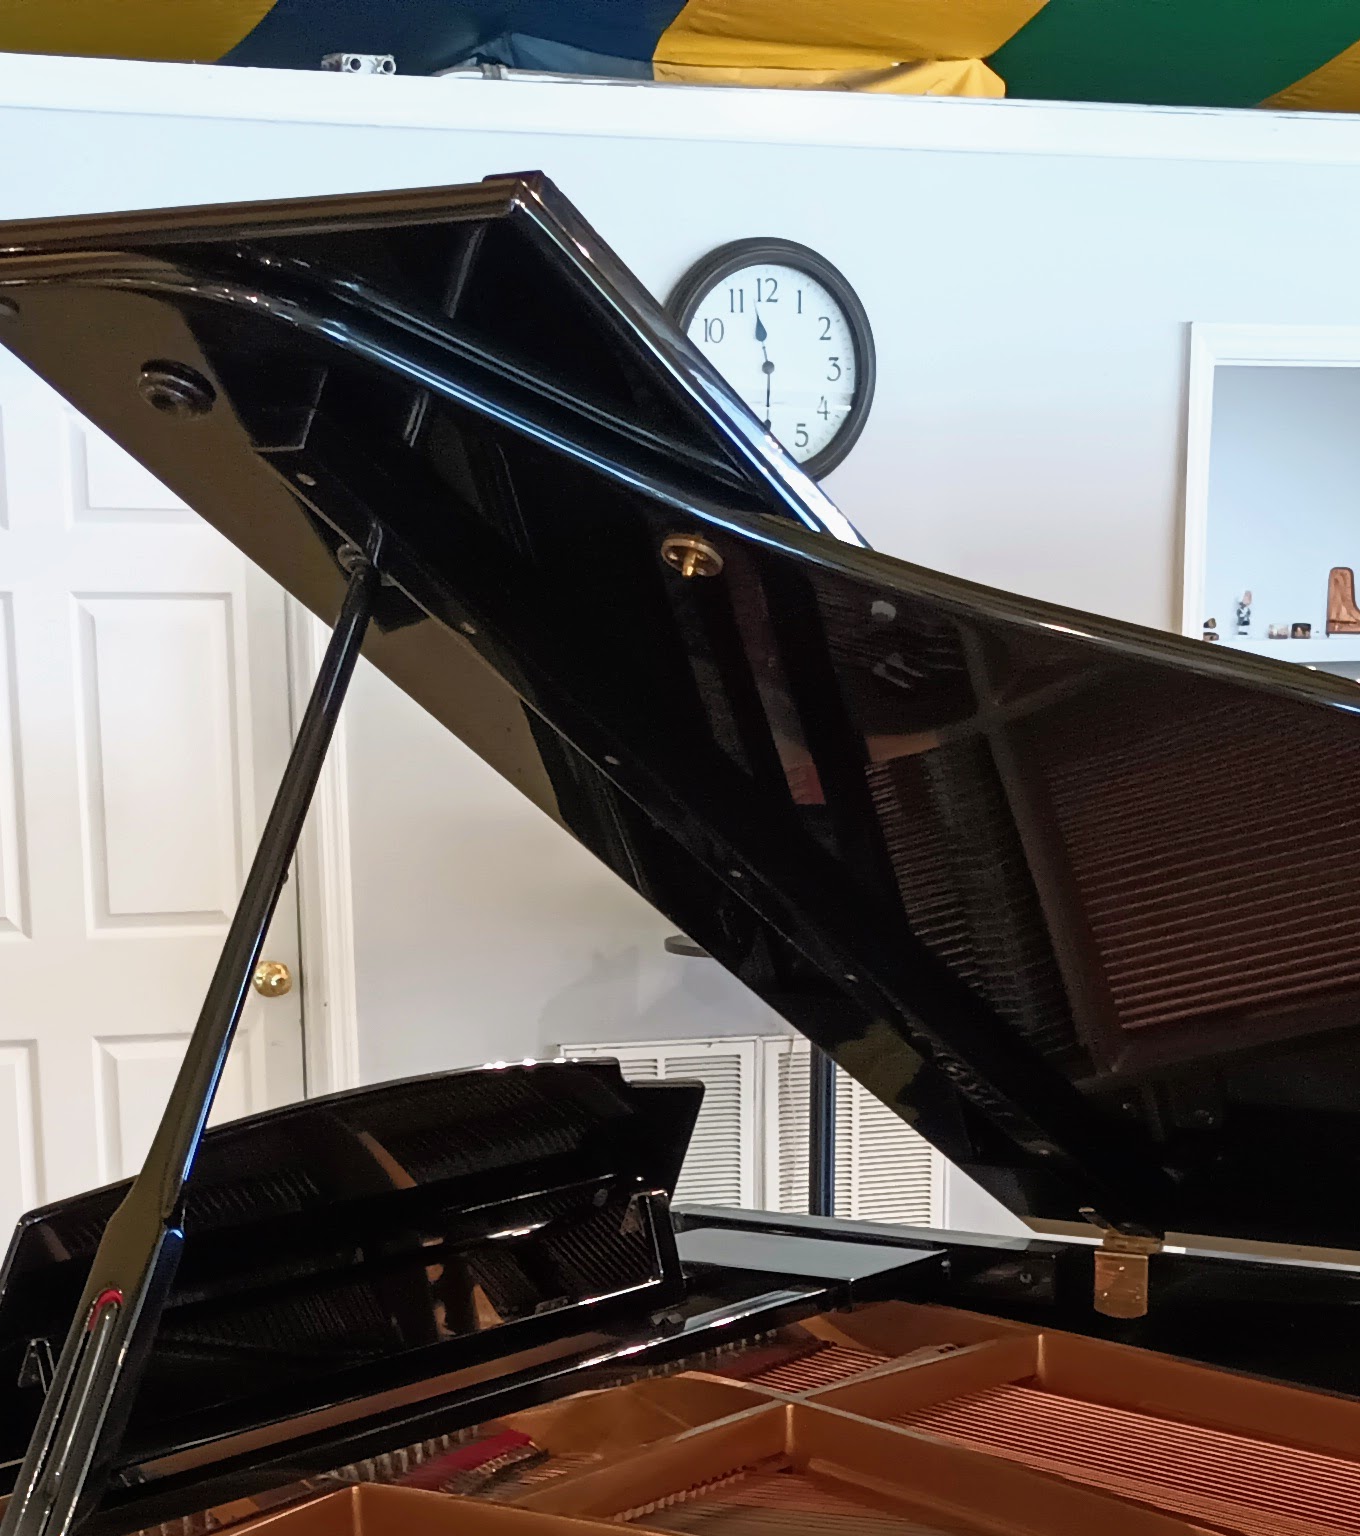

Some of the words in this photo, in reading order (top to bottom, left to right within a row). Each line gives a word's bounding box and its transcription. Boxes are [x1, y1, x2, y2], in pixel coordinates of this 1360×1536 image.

[729, 288, 744, 314] 11
[756, 277, 779, 303] 12
[797, 290, 803, 314] 1
[703, 317, 725, 343] 10
[818, 316, 832, 341] 2
[826, 356, 842, 382] 3
[816, 395, 831, 422] 4
[794, 423, 810, 448] 5
